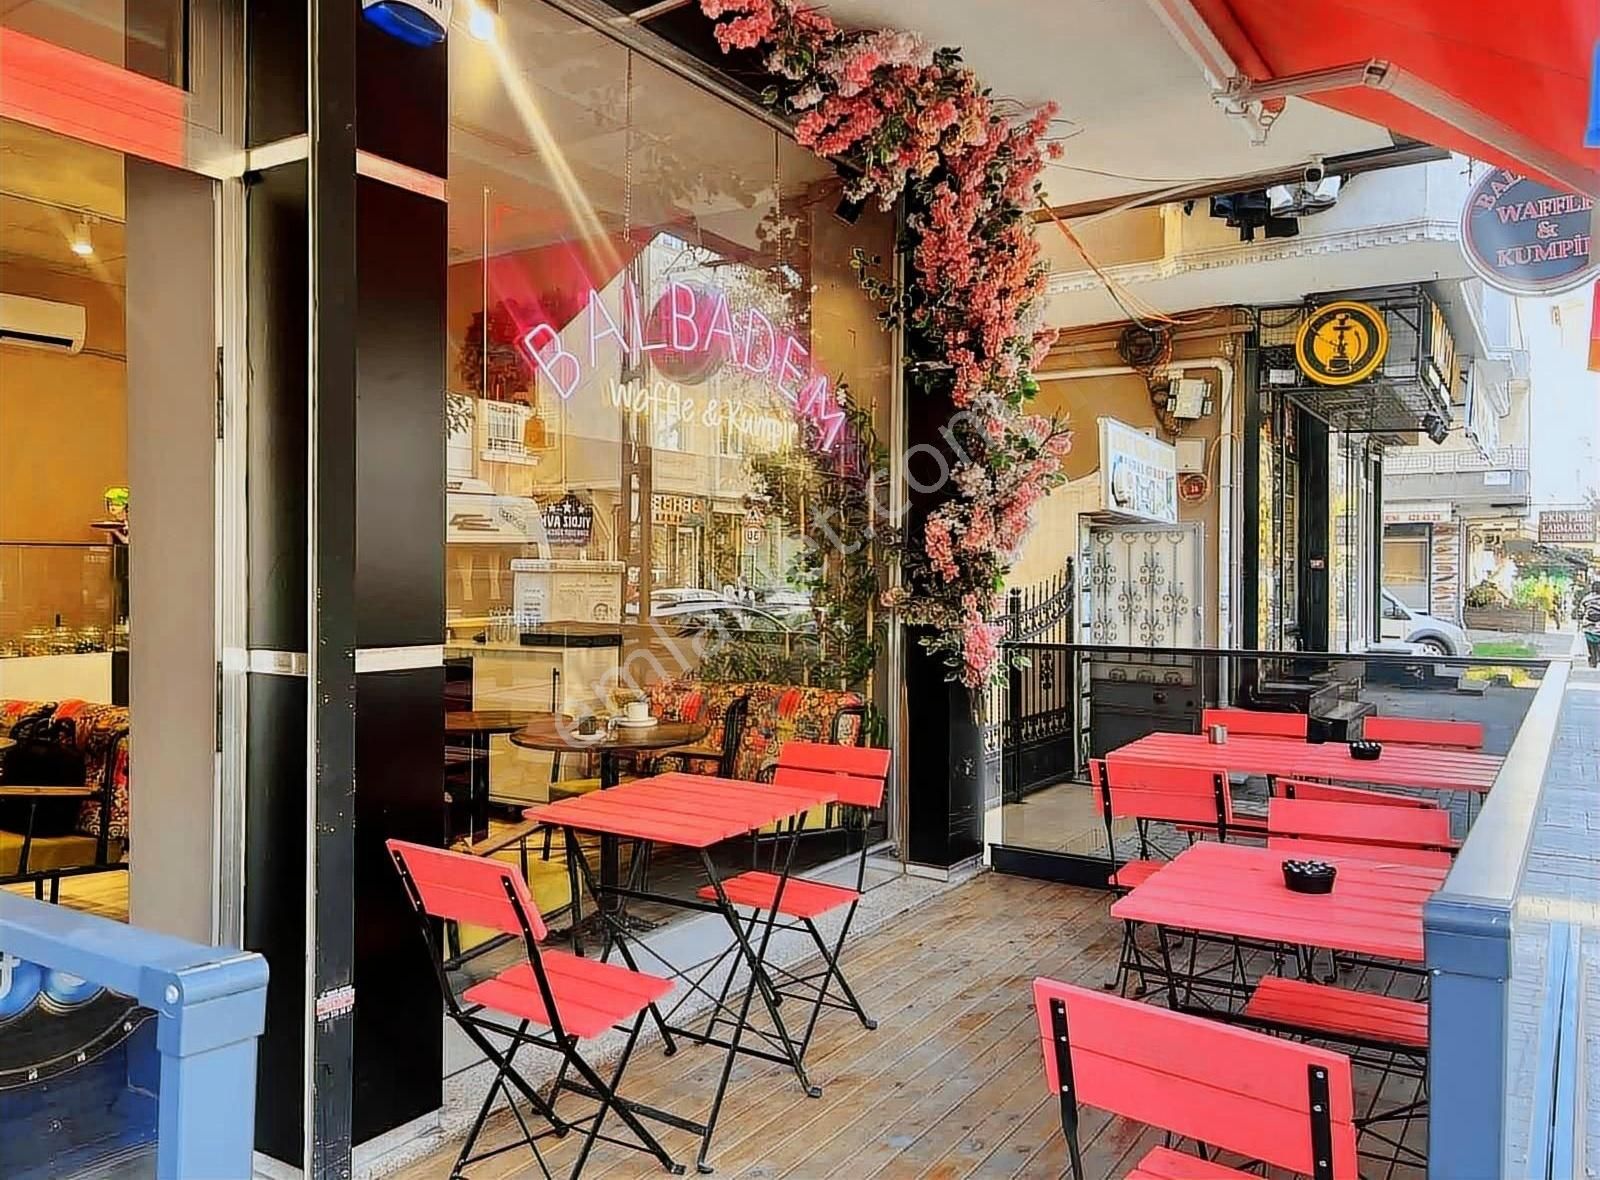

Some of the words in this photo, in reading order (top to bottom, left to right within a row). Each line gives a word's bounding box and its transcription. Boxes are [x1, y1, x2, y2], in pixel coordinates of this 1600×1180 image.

[1537, 220, 1559, 239] &
[522, 280, 846, 454] BALBADEM
[703, 399, 722, 427] &
